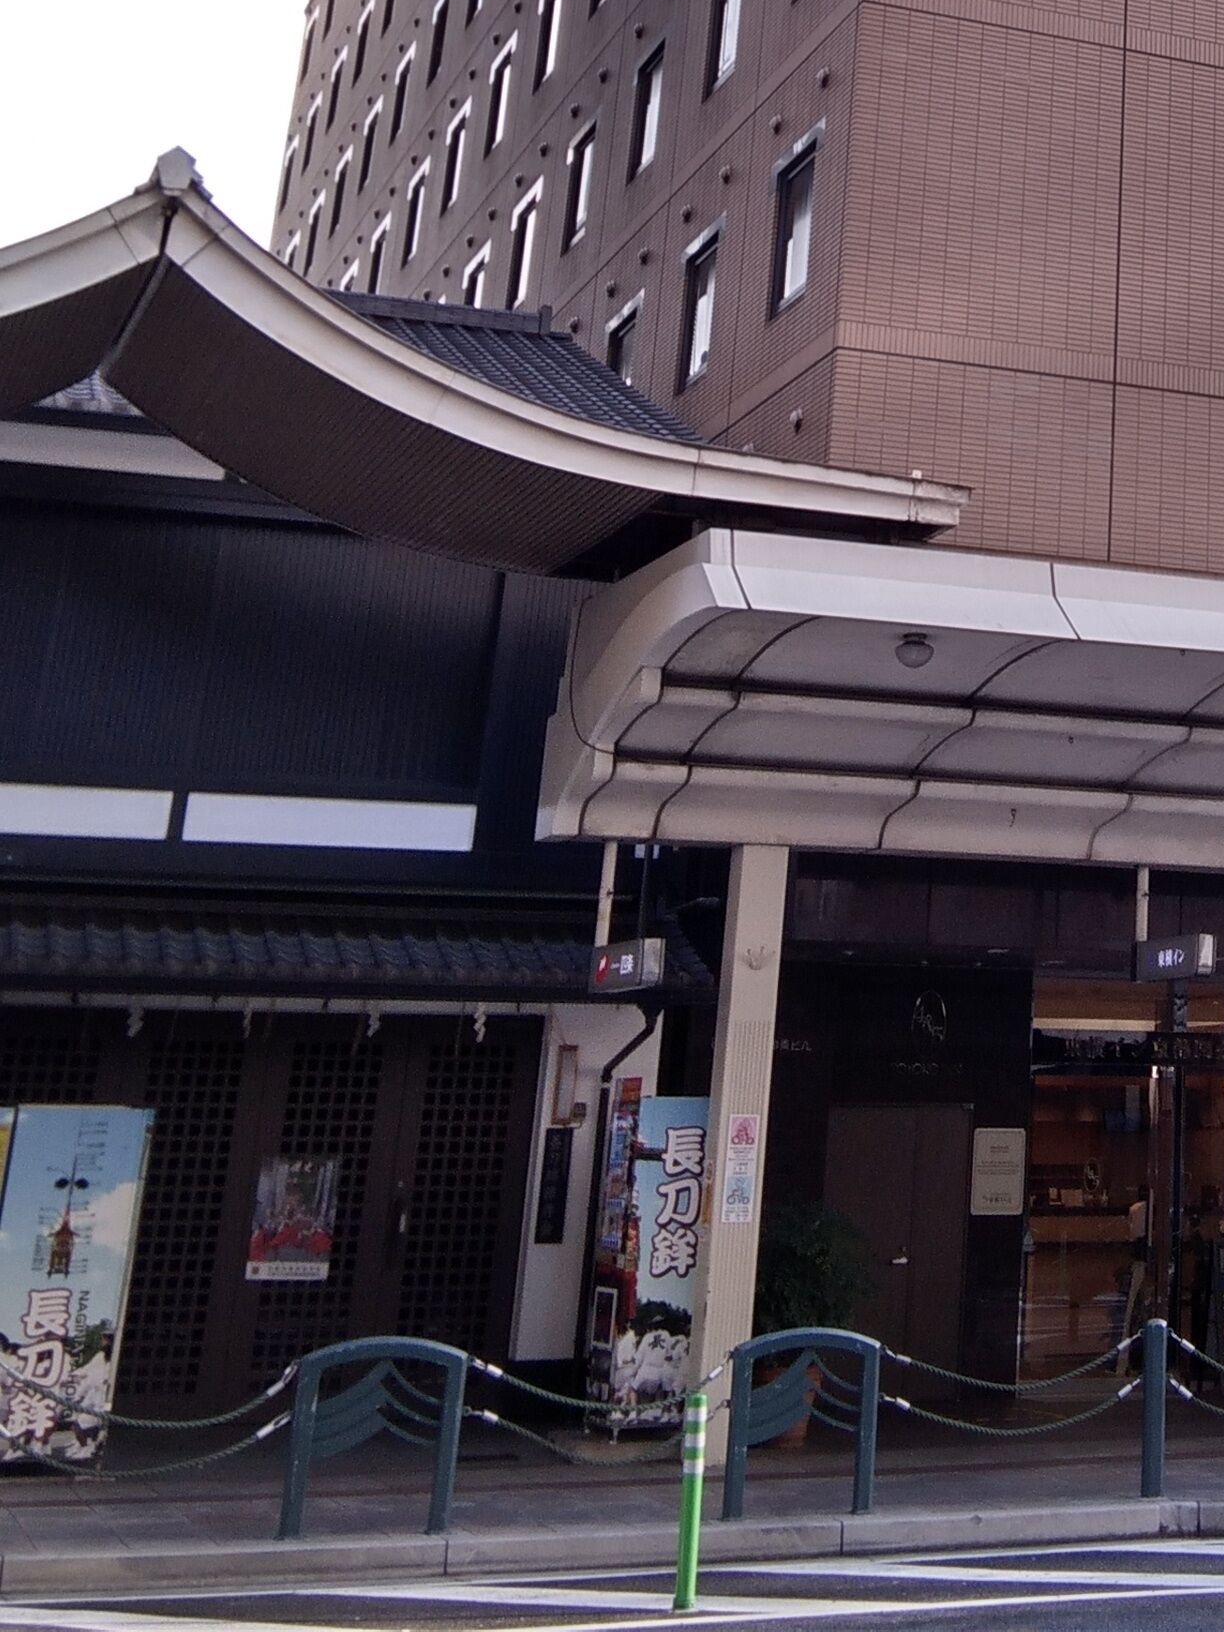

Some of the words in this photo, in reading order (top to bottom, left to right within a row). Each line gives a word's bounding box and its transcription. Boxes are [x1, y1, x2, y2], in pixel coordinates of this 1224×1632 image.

[650, 1126, 706, 1278] 長刀鉾
[6, 1287, 73, 1439] 長刀鉾
